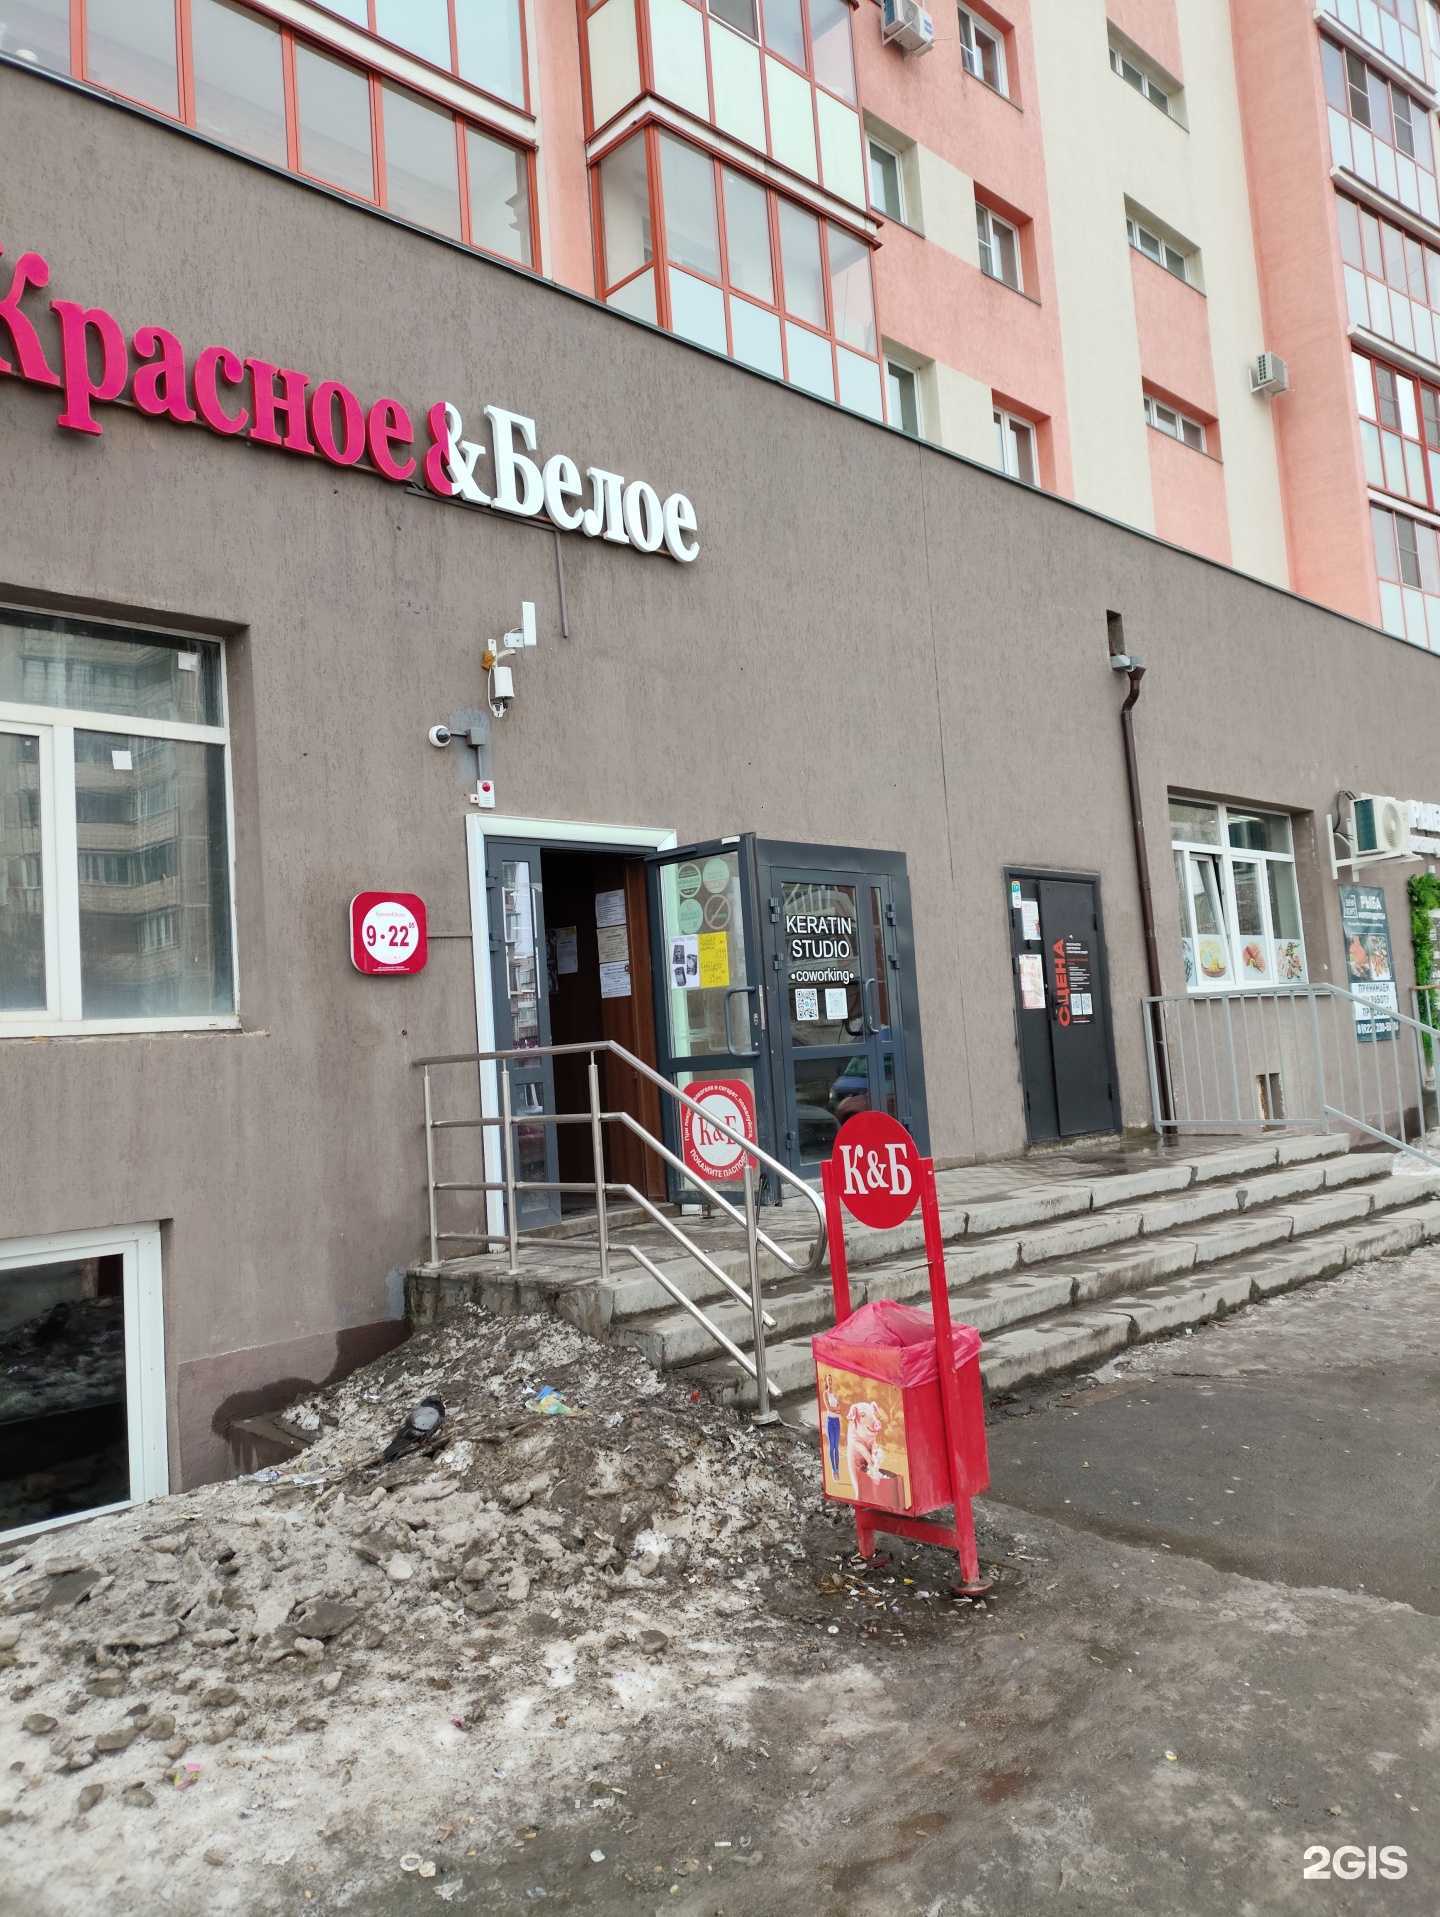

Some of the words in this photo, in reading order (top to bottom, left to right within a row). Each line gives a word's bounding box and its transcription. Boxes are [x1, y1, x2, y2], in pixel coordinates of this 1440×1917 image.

[786, 915, 852, 935] KERATIN
[792, 939, 850, 958] STUDIO
[690, 1148, 724, 1178] ПОКАЖИТЕ
[839, 1143, 913, 1195] К&Б
